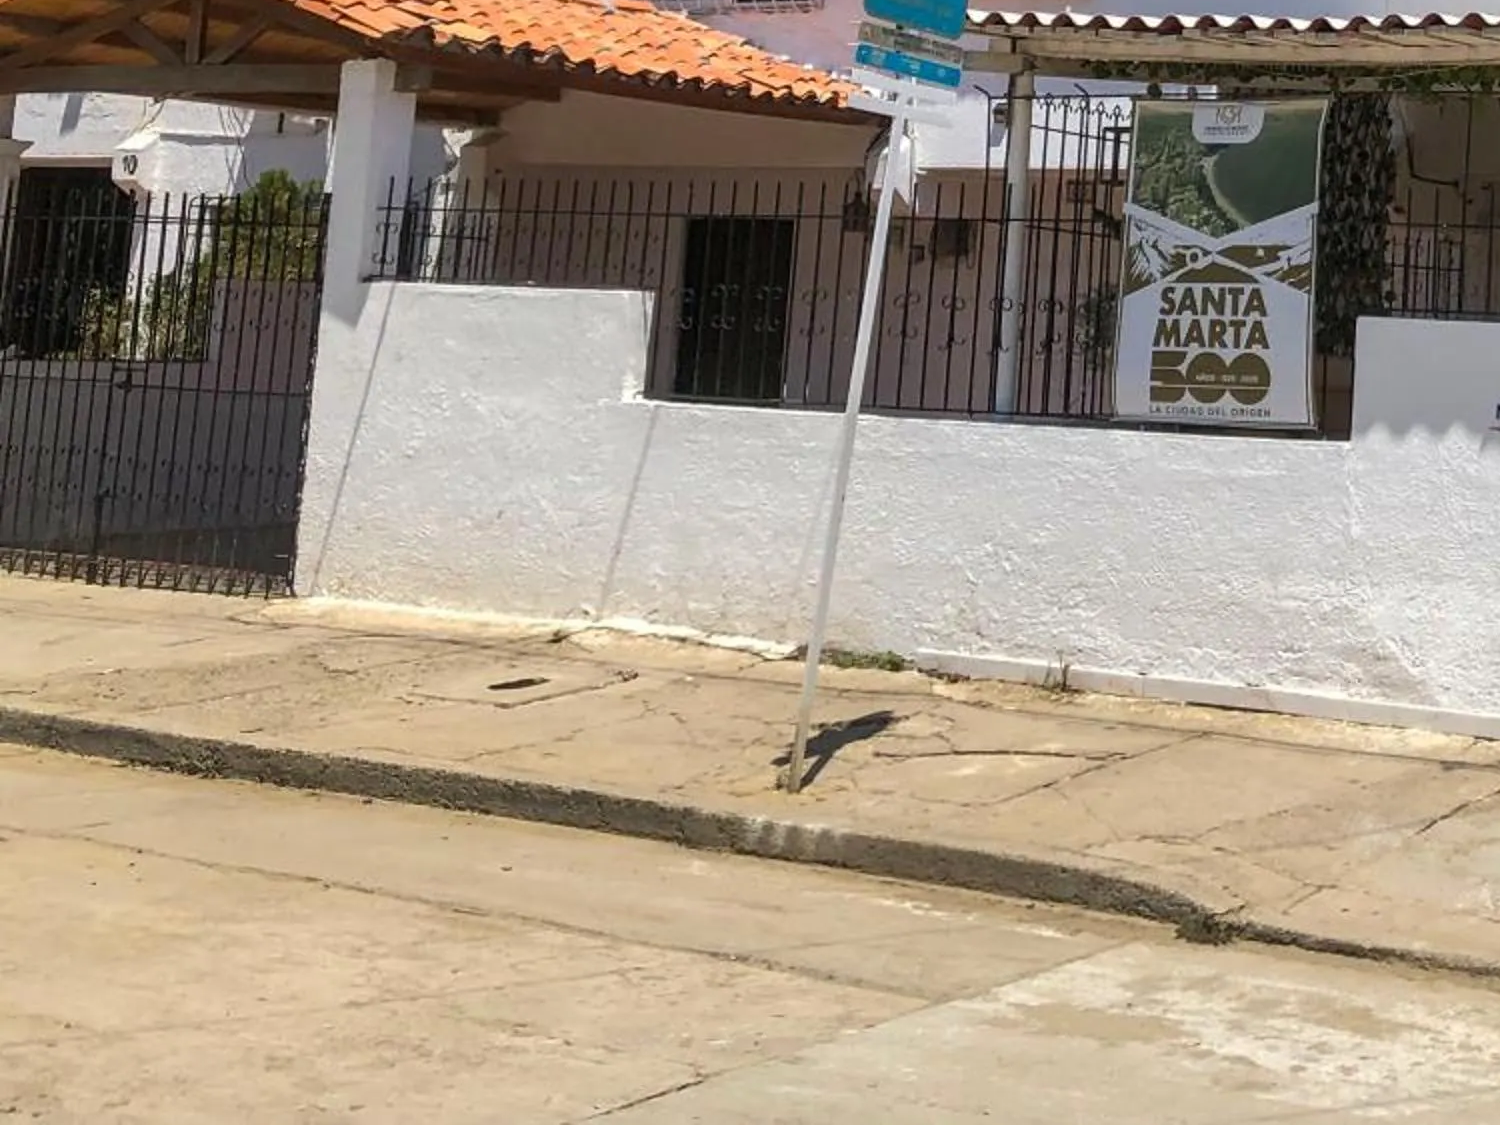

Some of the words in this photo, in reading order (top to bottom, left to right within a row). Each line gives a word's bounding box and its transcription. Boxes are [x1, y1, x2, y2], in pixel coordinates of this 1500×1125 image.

[1159, 286, 1268, 317] SANTA
[1153, 319, 1270, 350] MARTA
[1150, 350, 1271, 405] 500
[1166, 406, 1204, 416] CIUDAD
[1208, 407, 1225, 416] DEL
